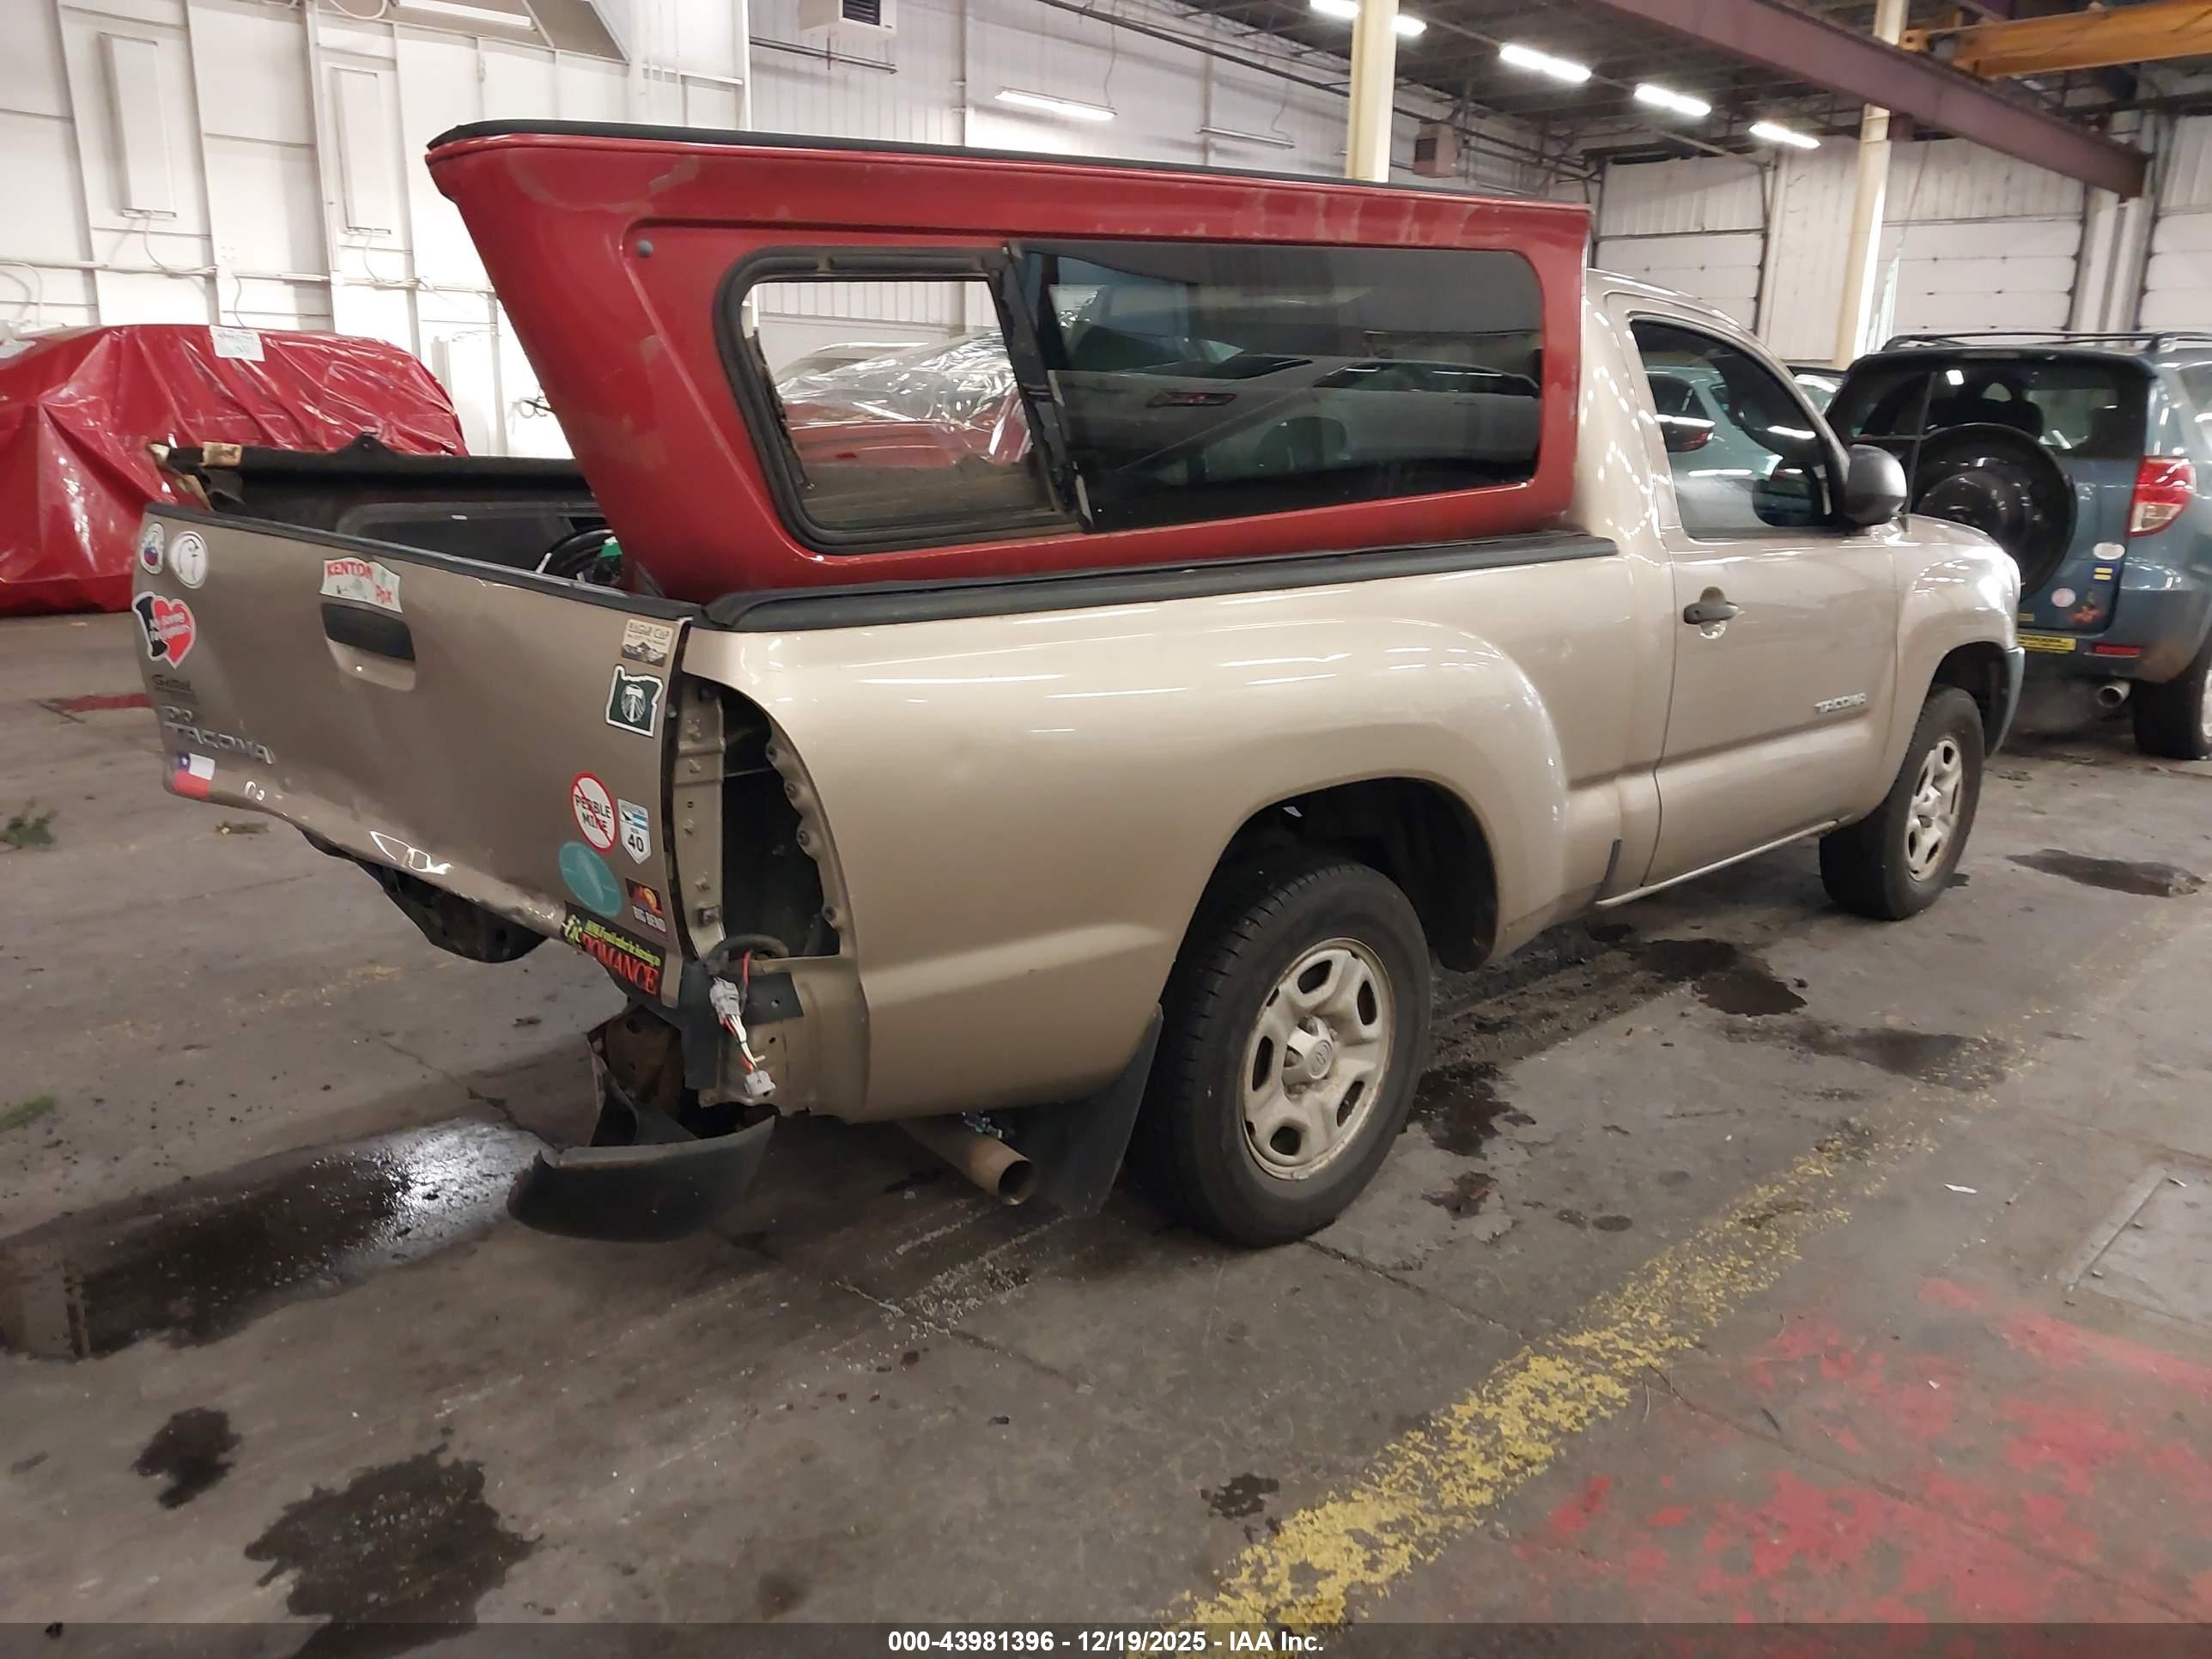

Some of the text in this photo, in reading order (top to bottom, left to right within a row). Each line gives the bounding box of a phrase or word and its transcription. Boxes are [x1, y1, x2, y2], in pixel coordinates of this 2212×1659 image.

[327, 561, 373, 580] KENTON
[574, 793, 612, 819] PEBBLE
[581, 811, 609, 834] MINE
[627, 833, 645, 854] 40
